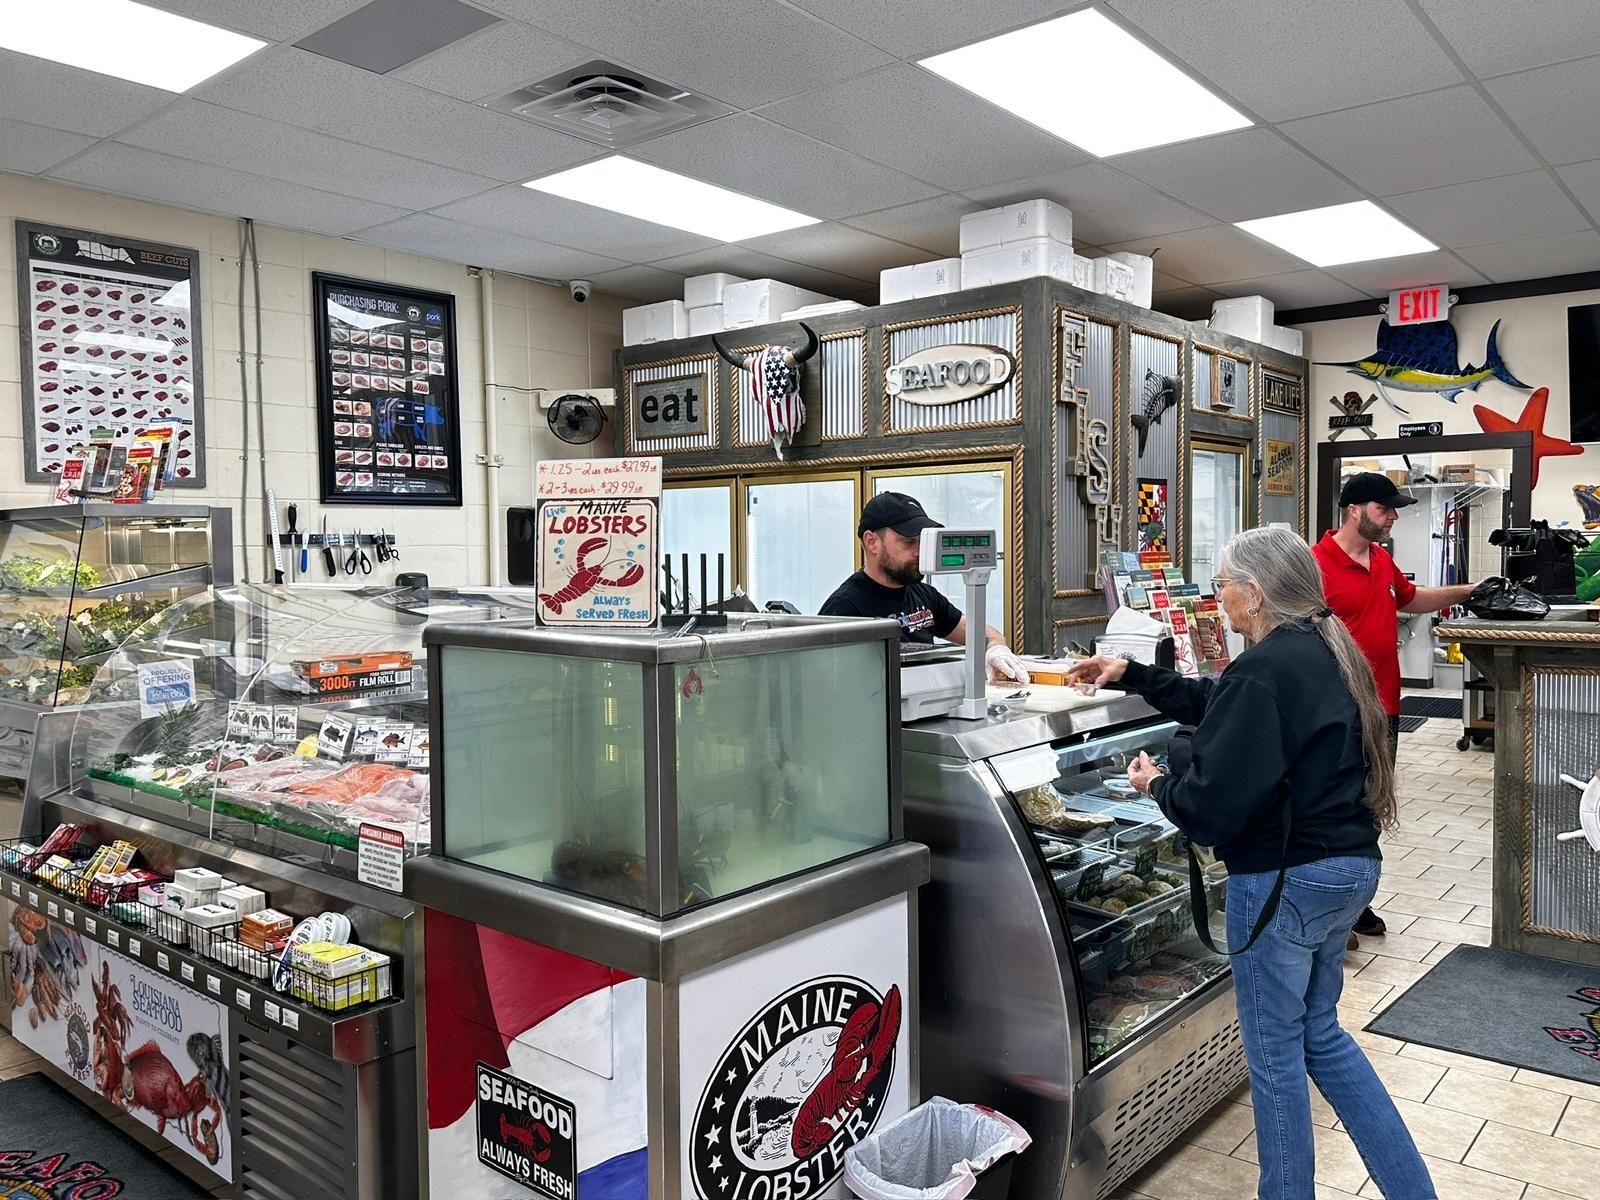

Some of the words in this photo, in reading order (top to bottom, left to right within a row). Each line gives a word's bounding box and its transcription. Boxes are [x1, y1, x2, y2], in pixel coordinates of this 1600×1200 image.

[140, 251, 163, 262] BEEF
[165, 255, 189, 266] CUTS
[329, 293, 377, 310] PURCHASING
[378, 300, 399, 313] PORK:
[1398, 288, 1441, 321] EXIT
[426, 313, 440, 321] pork
[885, 353, 1012, 397] SEAFOOD
[1265, 379, 1284, 407] LAKE
[1285, 384, 1300, 410] LIFE
[640, 387, 698, 424] eat
[1332, 418, 1350, 426] KEEP
[1354, 416, 1368, 424] OUT
[1270, 446, 1291, 466] ALASKA
[622, 460, 650, 474] $27.99
[1267, 457, 1293, 478] SEAFOOD
[546, 505, 567, 518] Live
[577, 500, 631, 515] MAINE
[549, 515, 647, 537] LOBSTERS
[143, 673, 190, 686] OFFERING
[151, 668, 181, 676] PROUDLY
[360, 676, 376, 687] FILM
[377, 674, 394, 684] ROLL
[360, 827, 382, 839] CONSUMER
[382, 831, 403, 845] ADVISORY
[293, 949, 311, 960] SCOUT
[312, 958, 330, 970] SCOUT
[130, 974, 181, 1018] LOUISIANA
[132, 990, 183, 1033] SEAFOOD
[738, 986, 858, 1075] MAINE
[479, 1073, 572, 1140] SEAFOOD
[731, 1110, 869, 1200] LOBSTER
[481, 1137, 531, 1178] ALWAYS
[533, 1162, 573, 1200] FRESH
